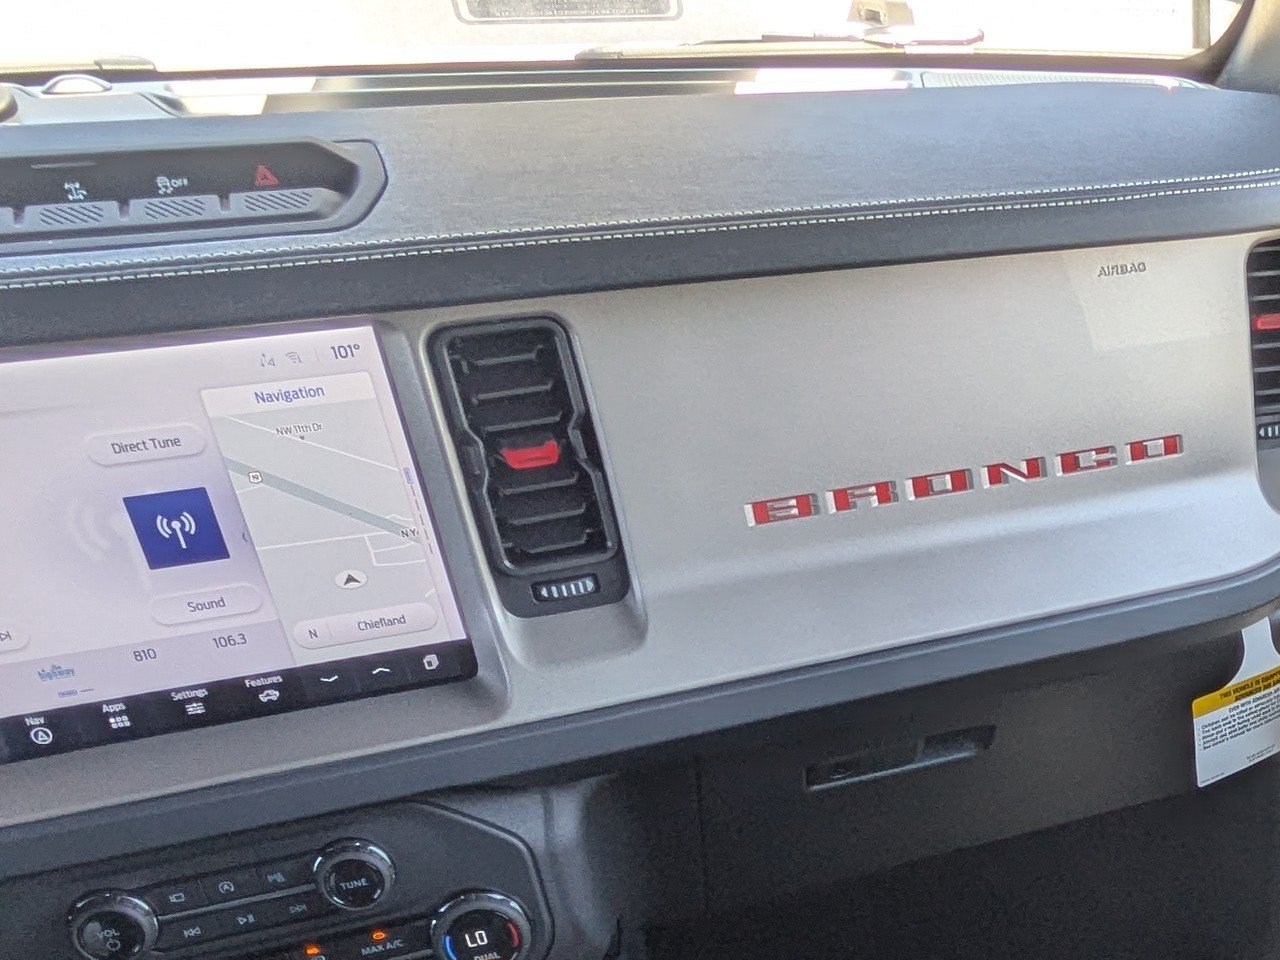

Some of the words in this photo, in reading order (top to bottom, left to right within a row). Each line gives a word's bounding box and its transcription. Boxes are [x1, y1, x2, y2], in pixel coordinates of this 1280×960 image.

[170, 177, 189, 188] OFF
[1097, 261, 1147, 277] AIRBAG
[254, 385, 325, 404] Navigation
[276, 425, 293, 436] NW
[312, 422, 323, 432] Dr
[110, 439, 149, 455] Direct
[150, 436, 182, 450] Tune
[744, 433, 1184, 528] BRONCO
[187, 597, 226, 613] Sound
[357, 615, 407, 632] Chiefland
[212, 633, 248, 649] 106.3
[308, 629, 318, 639] N
[133, 648, 157, 662] 810
[245, 675, 283, 688] Features
[171, 688, 209, 701] Settings
[102, 702, 126, 714] Apps
[25, 717, 45, 727] Nav
[340, 878, 369, 891] TUNE
[465, 930, 488, 948] LO
[361, 945, 386, 956] MAX
